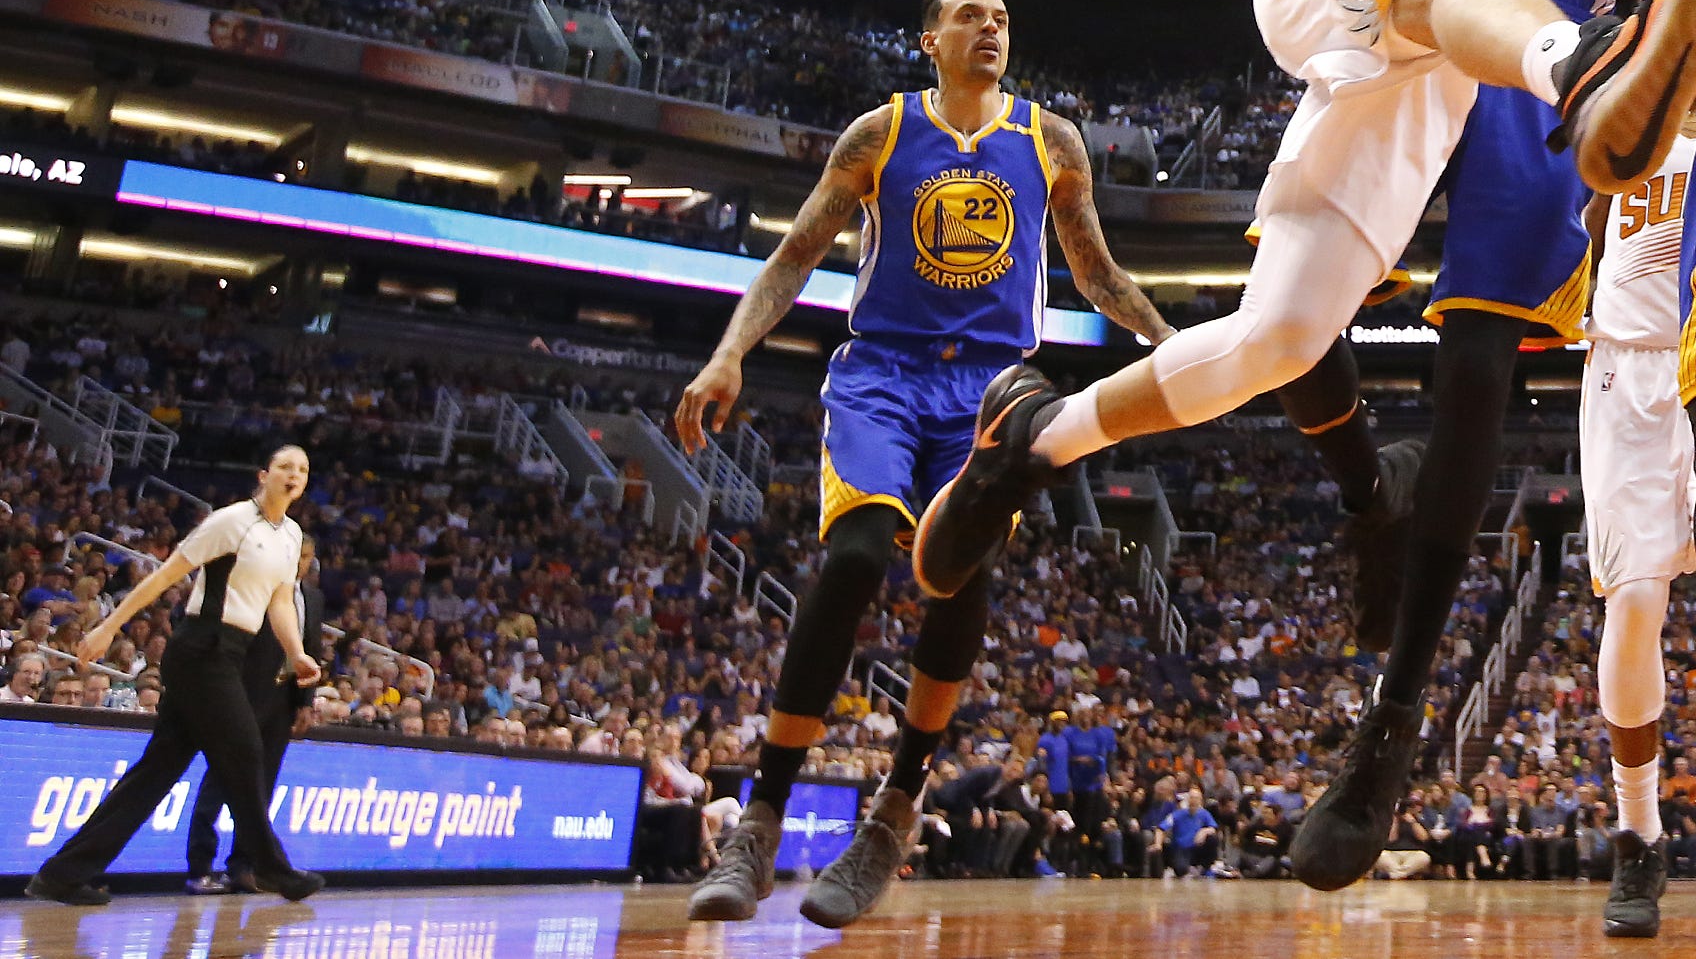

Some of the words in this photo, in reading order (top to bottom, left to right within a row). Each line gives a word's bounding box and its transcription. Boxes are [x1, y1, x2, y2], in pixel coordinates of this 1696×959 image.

[47, 159, 86, 185] AZ
[913, 168, 971, 199] GOLDEN
[976, 171, 1016, 199] STATE
[964, 198, 998, 220] 22
[1619, 172, 1688, 240] SU
[912, 254, 1015, 290] WARRIORS
[1350, 325, 1441, 345] Scottsdale,
[288, 776, 439, 849] vantage
[434, 780, 522, 850] point
[552, 810, 615, 840] nau.edu
